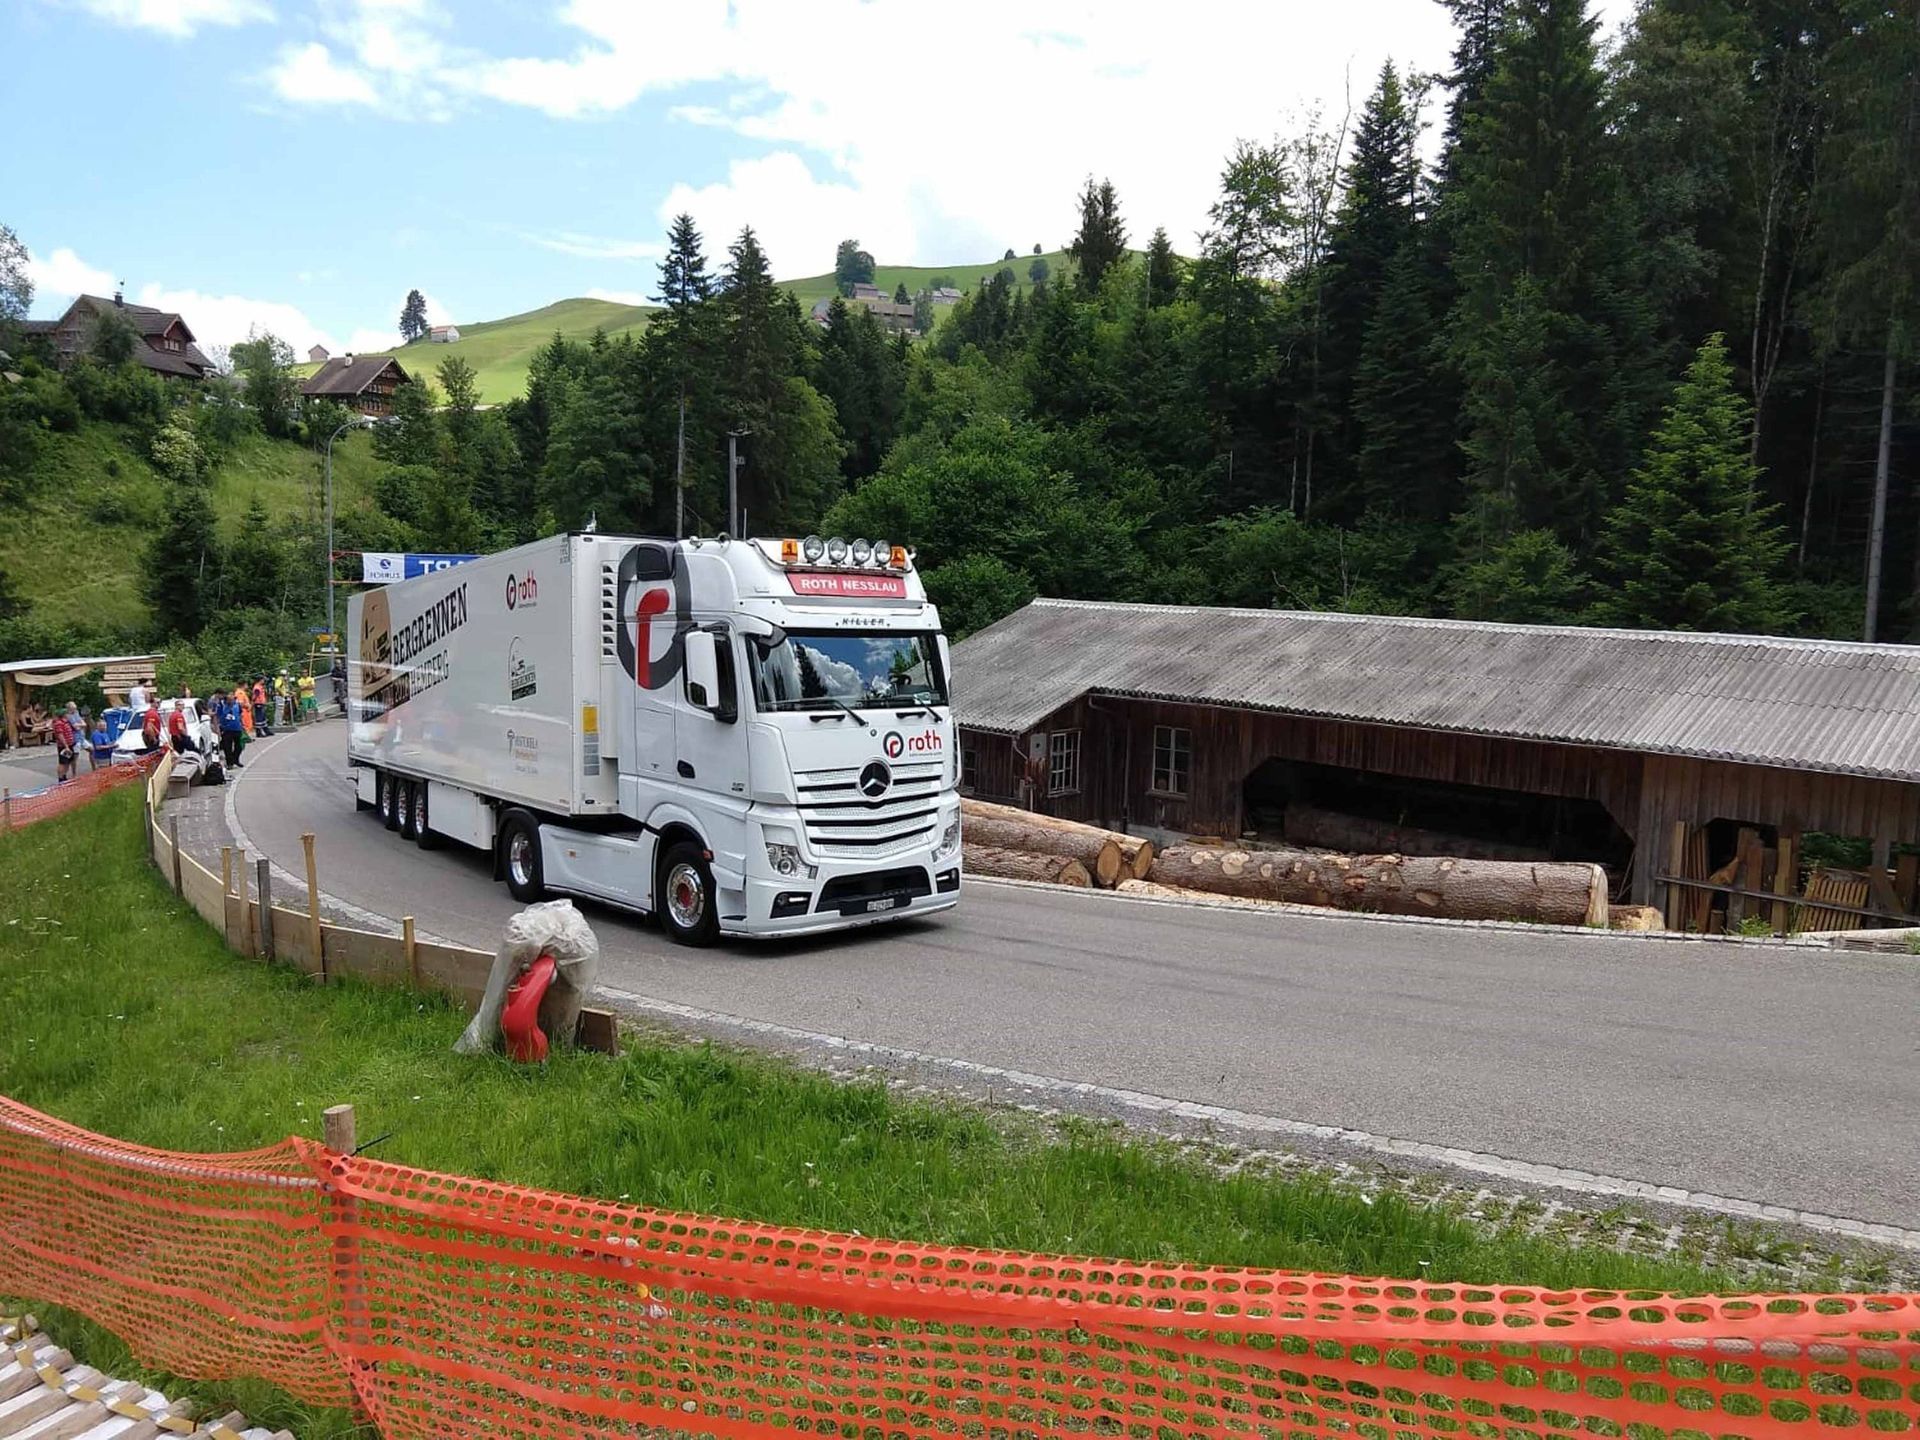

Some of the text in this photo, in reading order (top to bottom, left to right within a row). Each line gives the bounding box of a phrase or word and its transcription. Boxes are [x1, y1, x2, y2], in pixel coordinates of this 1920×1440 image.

[518, 570, 538, 600] roth
[801, 578, 897, 593] ROTH NESSLAU
[392, 582, 468, 666] BERGRENNEN
[908, 729, 942, 751] roth
